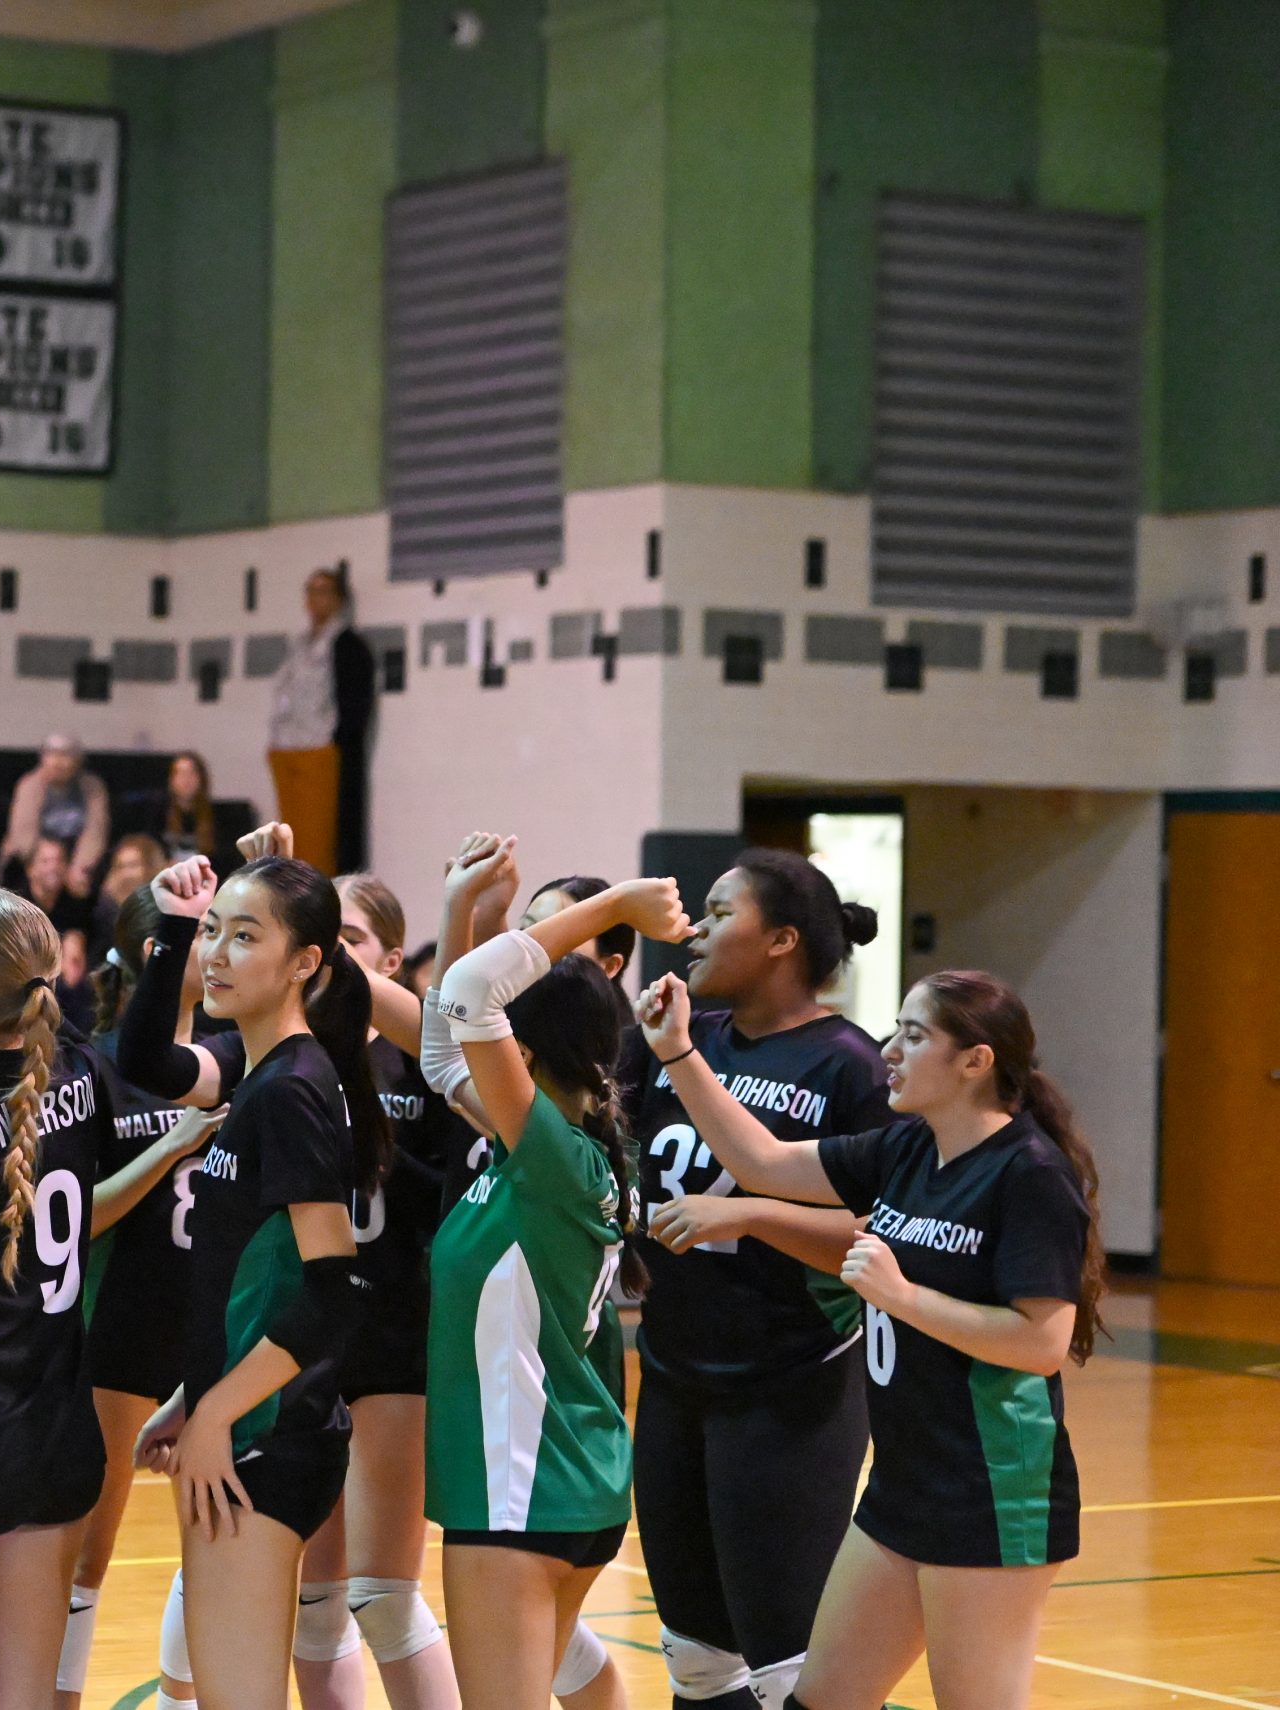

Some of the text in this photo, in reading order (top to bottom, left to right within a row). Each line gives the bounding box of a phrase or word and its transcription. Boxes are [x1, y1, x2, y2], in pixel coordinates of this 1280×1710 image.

[729, 1074, 827, 1127] JOHNSON
[201, 1142, 238, 1181] SON
[35, 1169, 82, 1314] 9
[895, 1216, 984, 1255] JOHNSON
